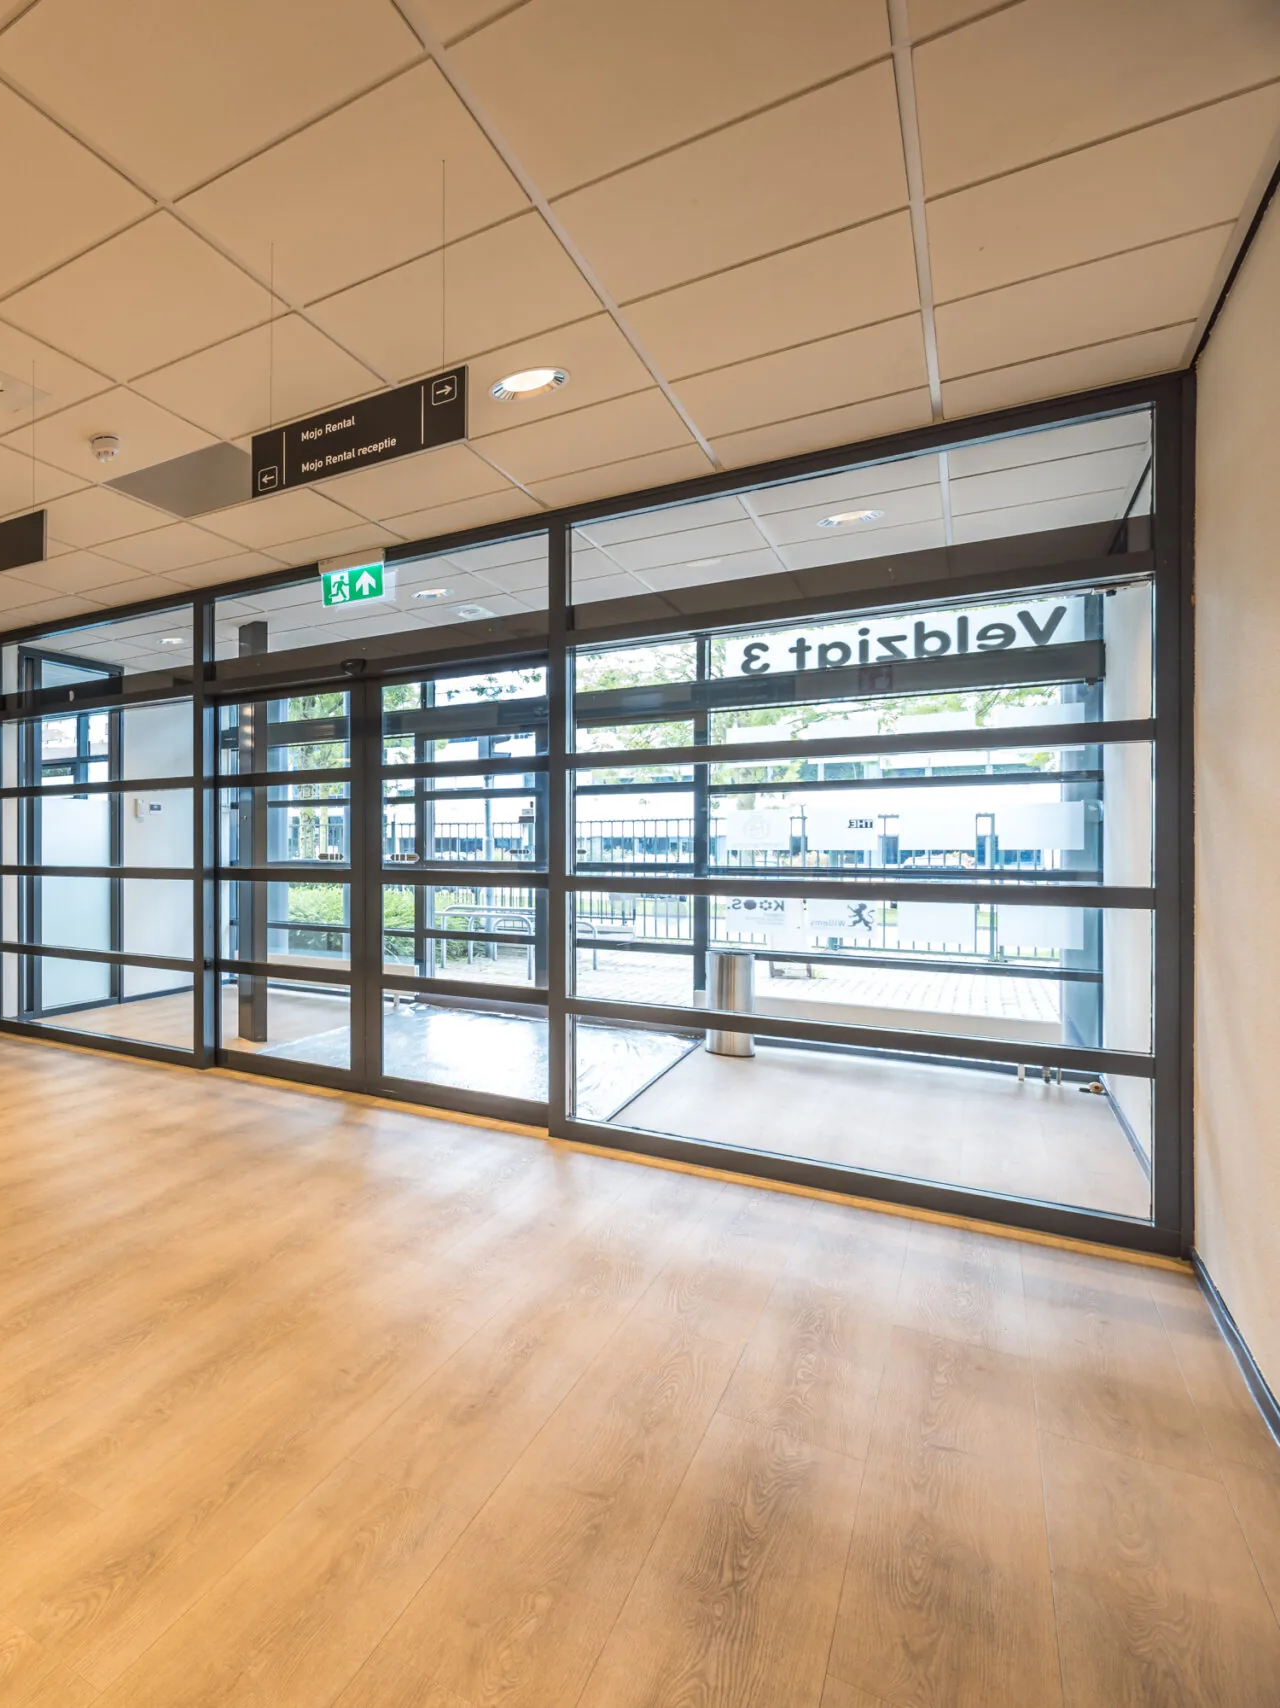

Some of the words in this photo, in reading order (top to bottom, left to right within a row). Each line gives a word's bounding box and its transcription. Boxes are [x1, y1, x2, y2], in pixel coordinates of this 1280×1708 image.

[301, 428, 323, 442] Mojo
[325, 415, 356, 434] Rental
[301, 460, 324, 473] Mojo
[325, 450, 356, 466] Rental
[357, 437, 397, 457] receptie
